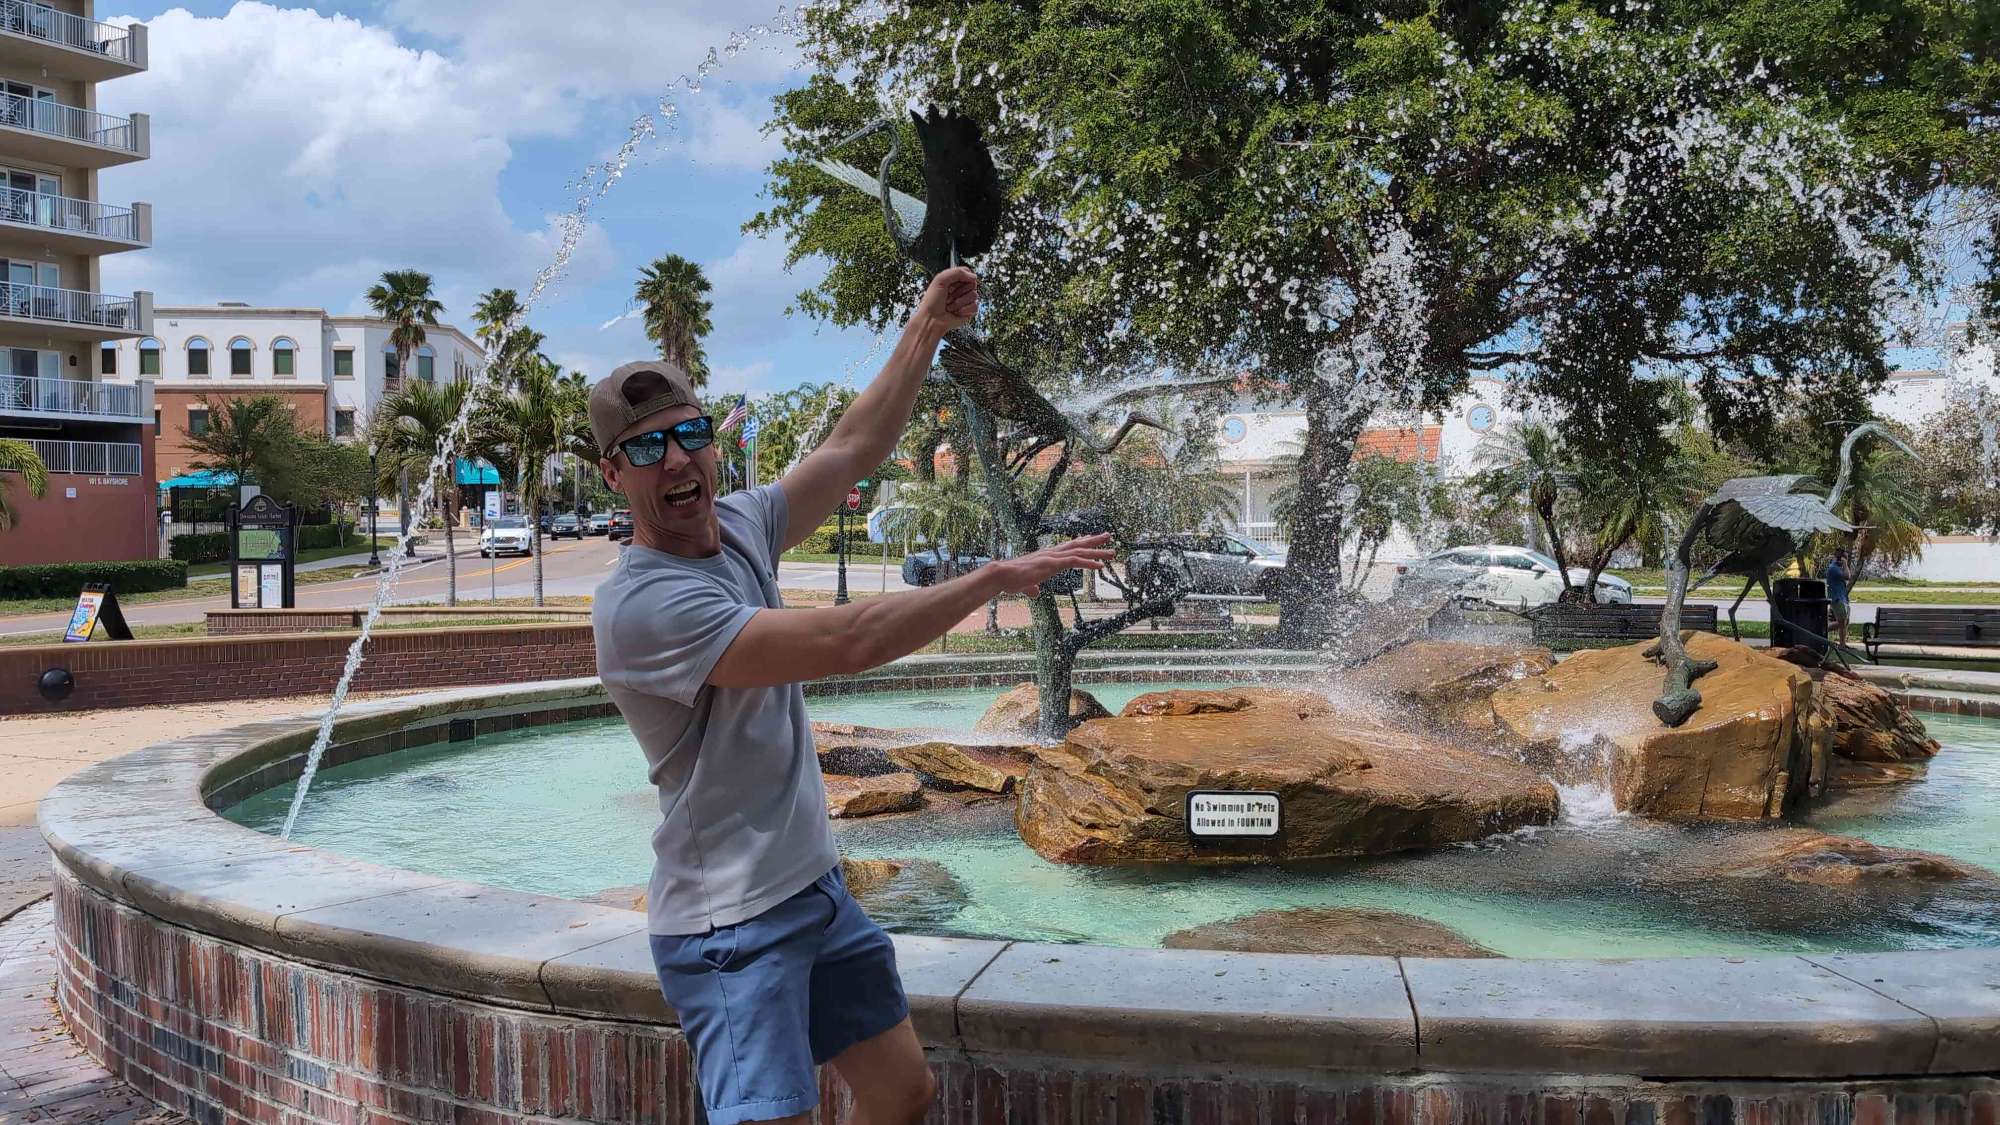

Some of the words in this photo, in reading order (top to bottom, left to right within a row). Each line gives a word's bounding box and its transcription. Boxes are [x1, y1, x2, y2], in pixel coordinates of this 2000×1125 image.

[1195, 802, 1204, 811] No
[1206, 801, 1244, 813] Swimming
[1256, 802, 1275, 812] Pets
[1197, 817, 1225, 827] Allowed
[1237, 817, 1272, 827] FOUNTAIN
